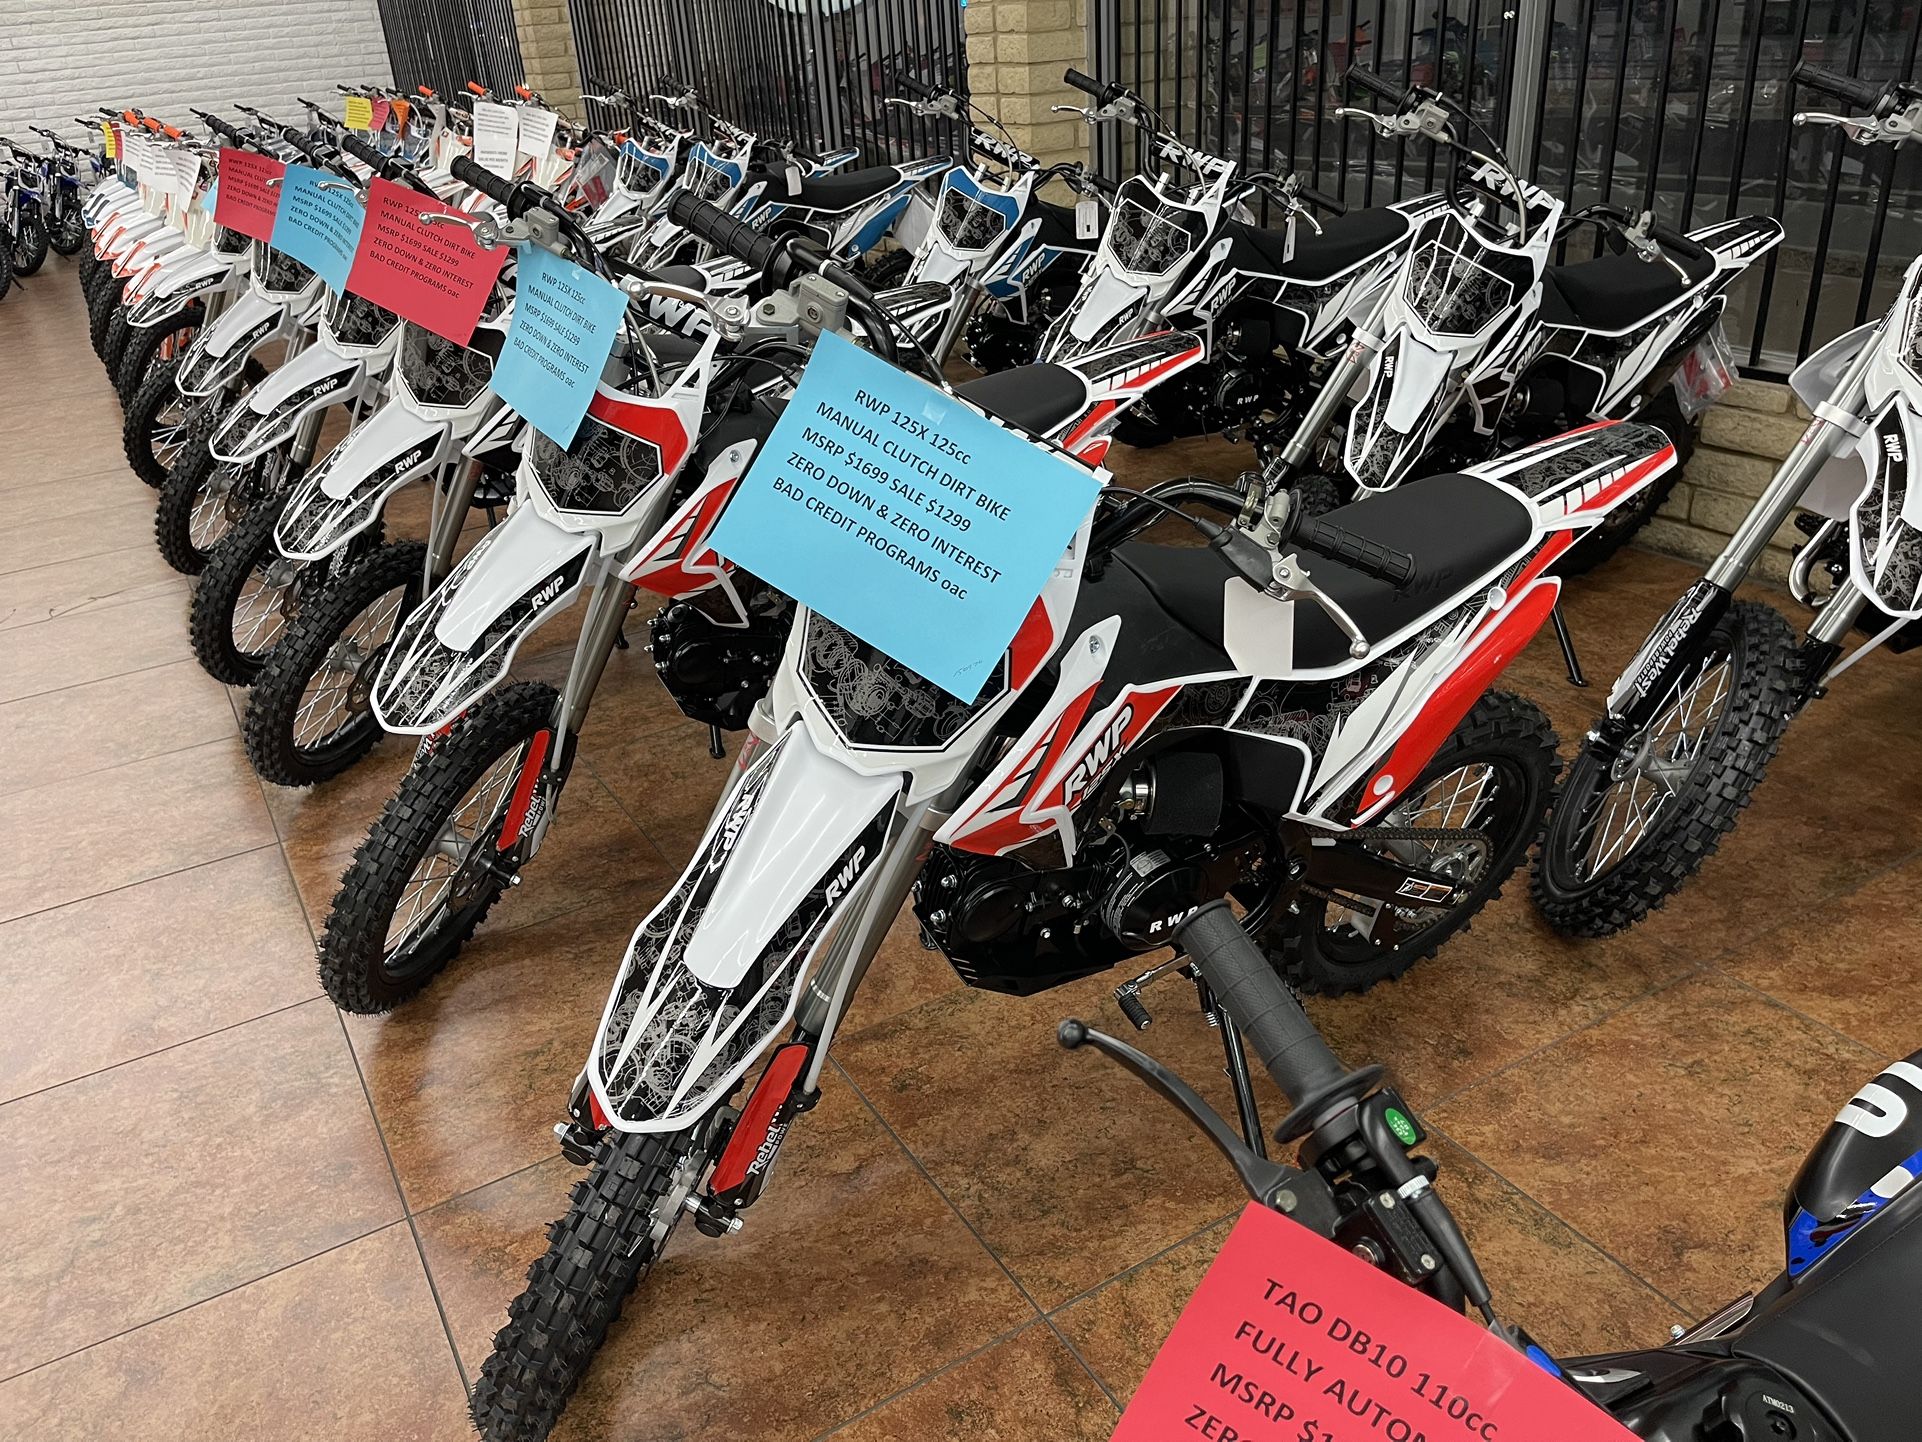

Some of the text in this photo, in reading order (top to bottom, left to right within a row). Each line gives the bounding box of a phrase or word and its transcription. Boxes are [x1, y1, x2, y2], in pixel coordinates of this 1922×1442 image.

[1160, 142, 1228, 175] RWP
[293, 195, 313, 207] MSRP
[314, 204, 332, 218] $1699
[295, 186, 326, 203] MANUAL
[327, 200, 346, 216] CLUTCH
[383, 197, 403, 209] RWP
[405, 206, 420, 217] 125
[1471, 162, 1557, 210] RWP
[288, 216, 302, 226] BAD
[304, 224, 324, 239] CREDIT
[291, 206, 308, 217] ZERO
[310, 214, 329, 229] DOWN
[381, 211, 476, 259] MANUAL CLUTCH DIRT BIKE
[752, 207, 771, 230] RWP
[374, 237, 474, 289] ZERO DOWN & ZERO INTEREST
[377, 224, 460, 266] MSRP $1699 SALE $1299
[195, 278, 214, 289] RWP
[370, 251, 460, 298] BAD CREDIT PROGRAMS oac
[542, 272, 586, 304] RWP 125X 125cc
[1023, 252, 1045, 283] RWP
[528, 285, 596, 333] MANUAL CLUTCH DIRT BIKE
[1211, 277, 1236, 313] RWP
[252, 322, 269, 339] RWP
[525, 303, 581, 345] MSRP $1699 SALE $1299
[1119, 309, 1134, 326] RWP
[513, 337, 575, 388] BAD CREDIT PROGRAMS oac
[520, 320, 589, 374] ZERO DOWN & ZERO INTEREST
[1384, 355, 1395, 378] RWP
[313, 378, 338, 397] RWP
[854, 390, 971, 465] RWP 125X 125cc
[1883, 434, 1903, 462] RWP
[395, 450, 422, 474] RWP
[802, 427, 971, 532] MSRP $1699 SALE $1299
[816, 402, 1011, 521] MANUAL CLUTCH DIRT BIKE
[773, 477, 968, 600] BAD CREDIT PROGRAMS oac
[787, 452, 1002, 583] ZERO DOWN & ZERO INTEREST
[531, 575, 564, 611] RWP
[1634, 654, 1670, 699] West
[1065, 706, 1132, 805] RWP
[519, 794, 541, 837] Rebel
[825, 845, 866, 907] RWP
[746, 1124, 782, 1175] Rebel
[1235, 1321, 1324, 1382] FULLY
[1262, 1278, 1499, 1442] TAO DB10 110cc
[1210, 1362, 1295, 1423] MSRP
[1184, 1404, 1239, 1442] ZER
